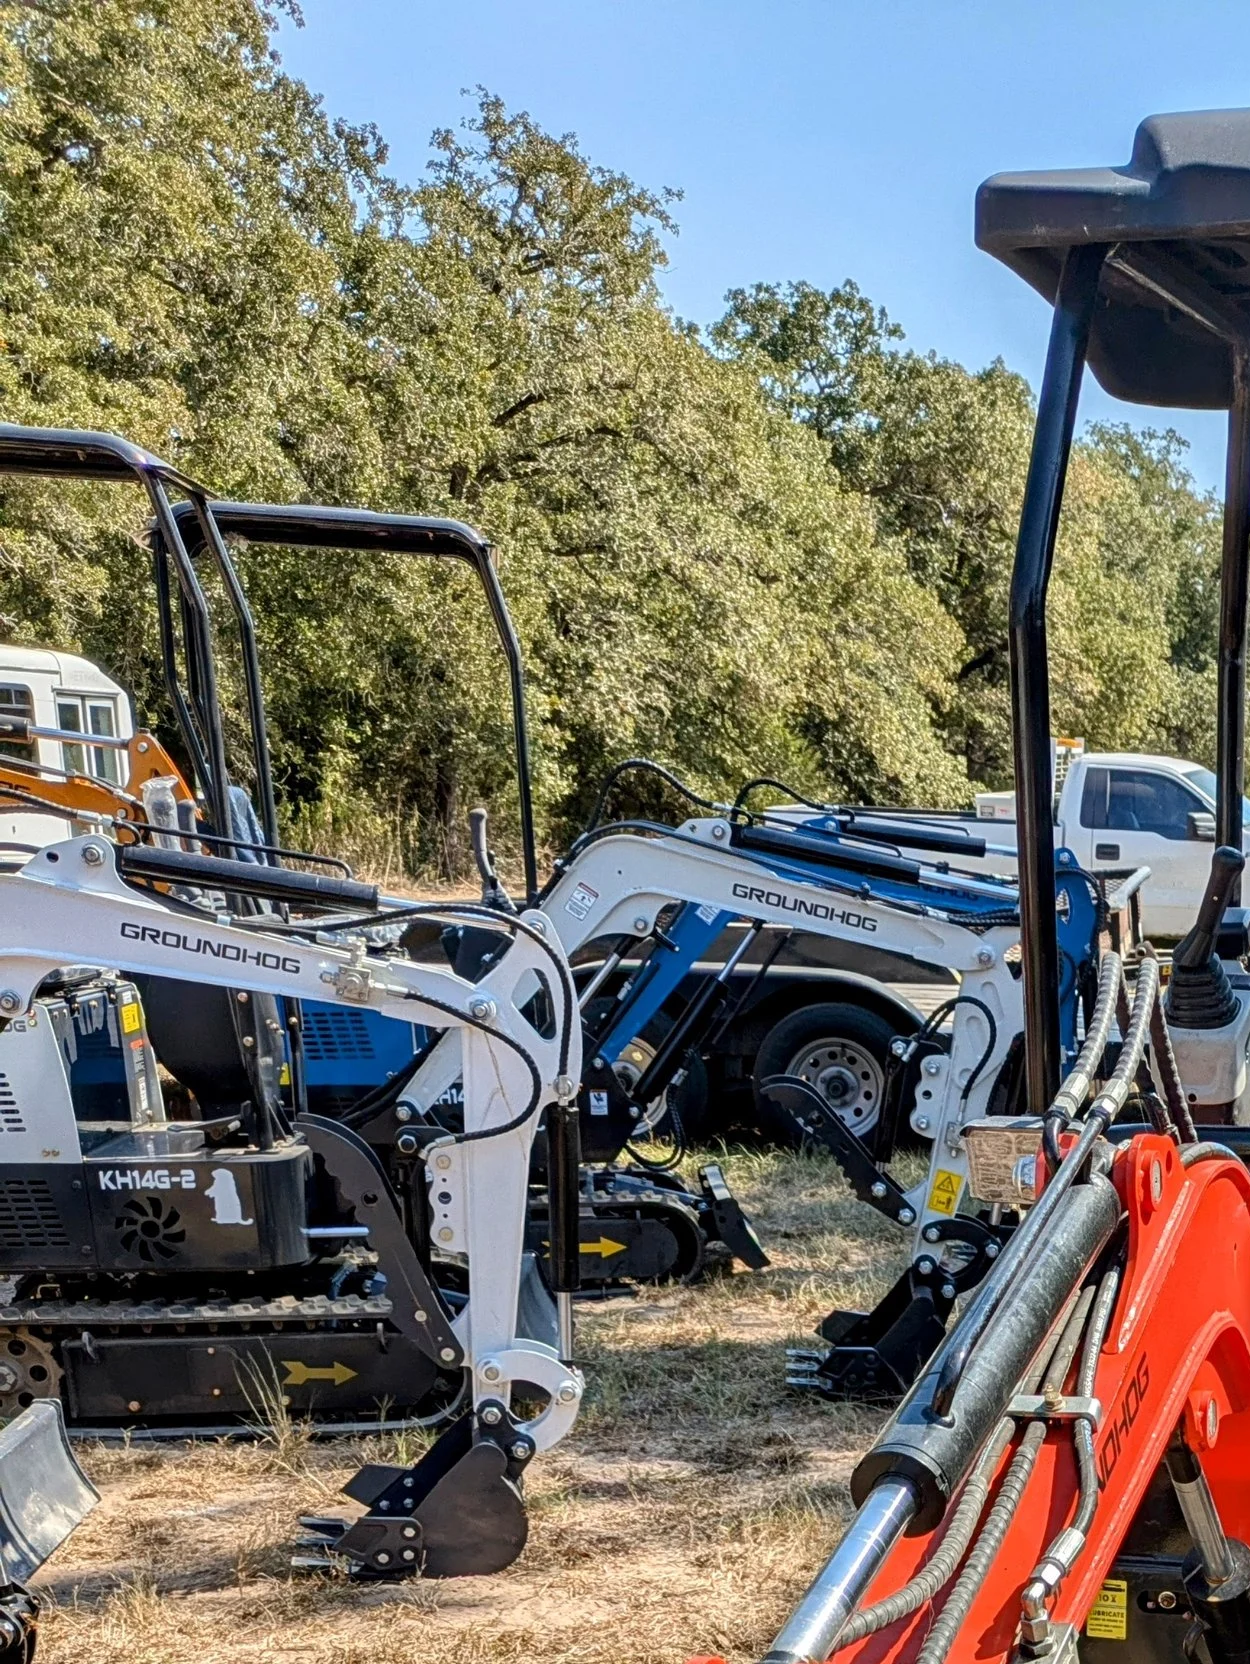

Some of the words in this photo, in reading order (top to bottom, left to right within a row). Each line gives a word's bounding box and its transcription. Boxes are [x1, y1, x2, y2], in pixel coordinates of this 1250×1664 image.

[732, 882, 878, 932] GROUNDHOG
[120, 922, 301, 974] GROUNDHOG
[98, 1169, 196, 1190] KH14G-2
